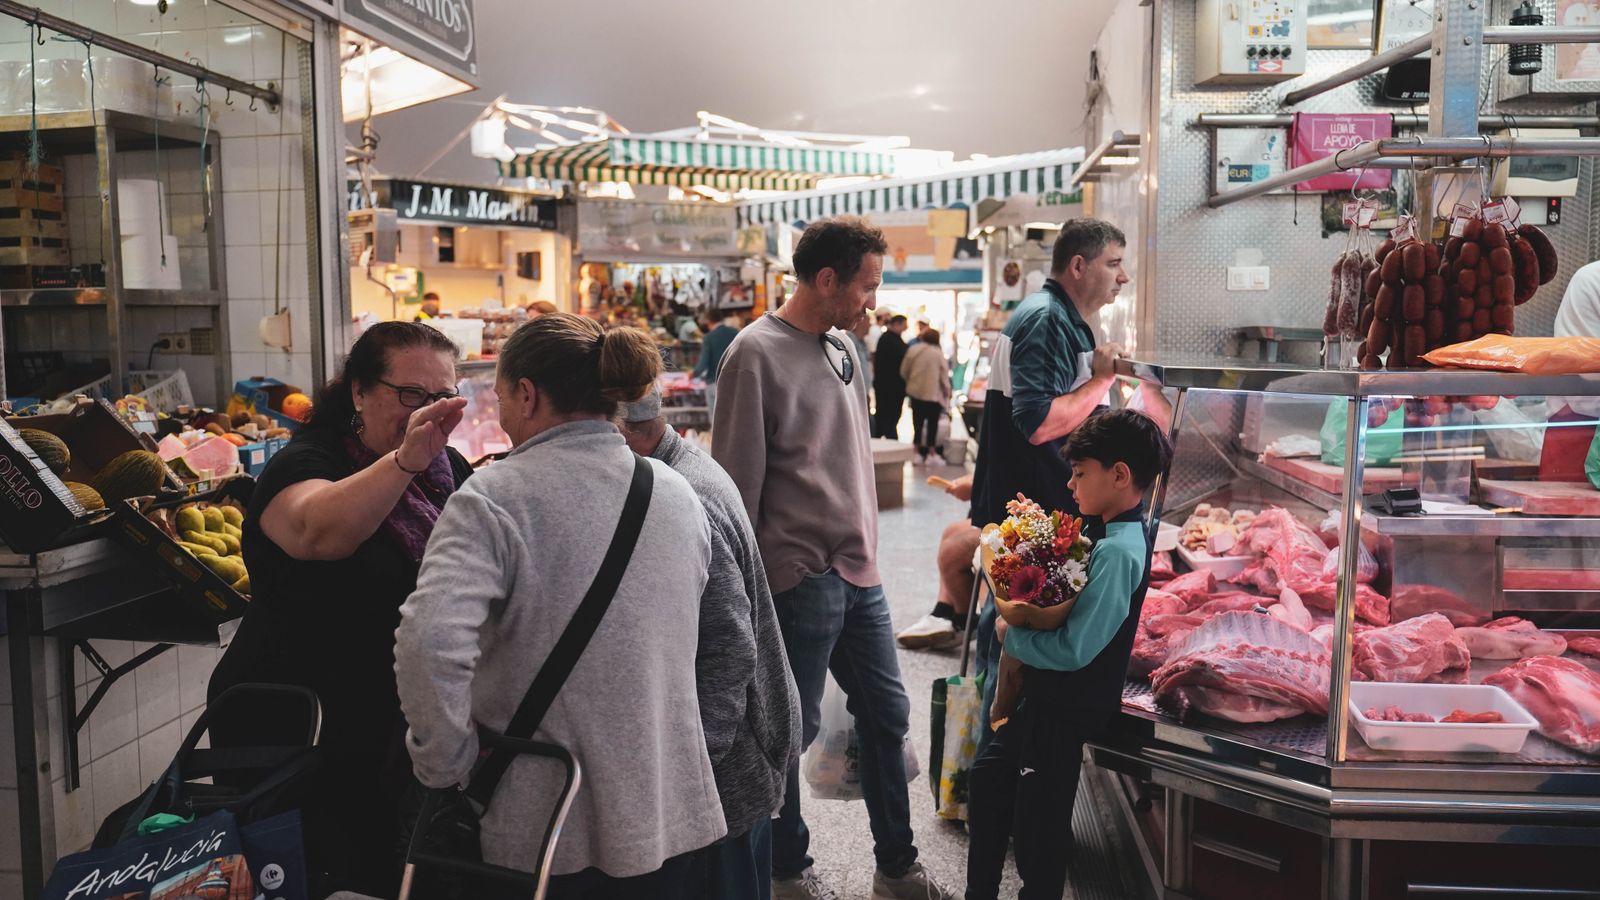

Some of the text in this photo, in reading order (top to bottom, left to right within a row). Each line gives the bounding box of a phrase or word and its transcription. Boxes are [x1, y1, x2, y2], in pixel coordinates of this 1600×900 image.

[1330, 123, 1348, 134] LLENA
[1323, 135, 1363, 148] APOYO
[405, 185, 460, 218] J.M.
[64, 829, 226, 900] Andalucía
